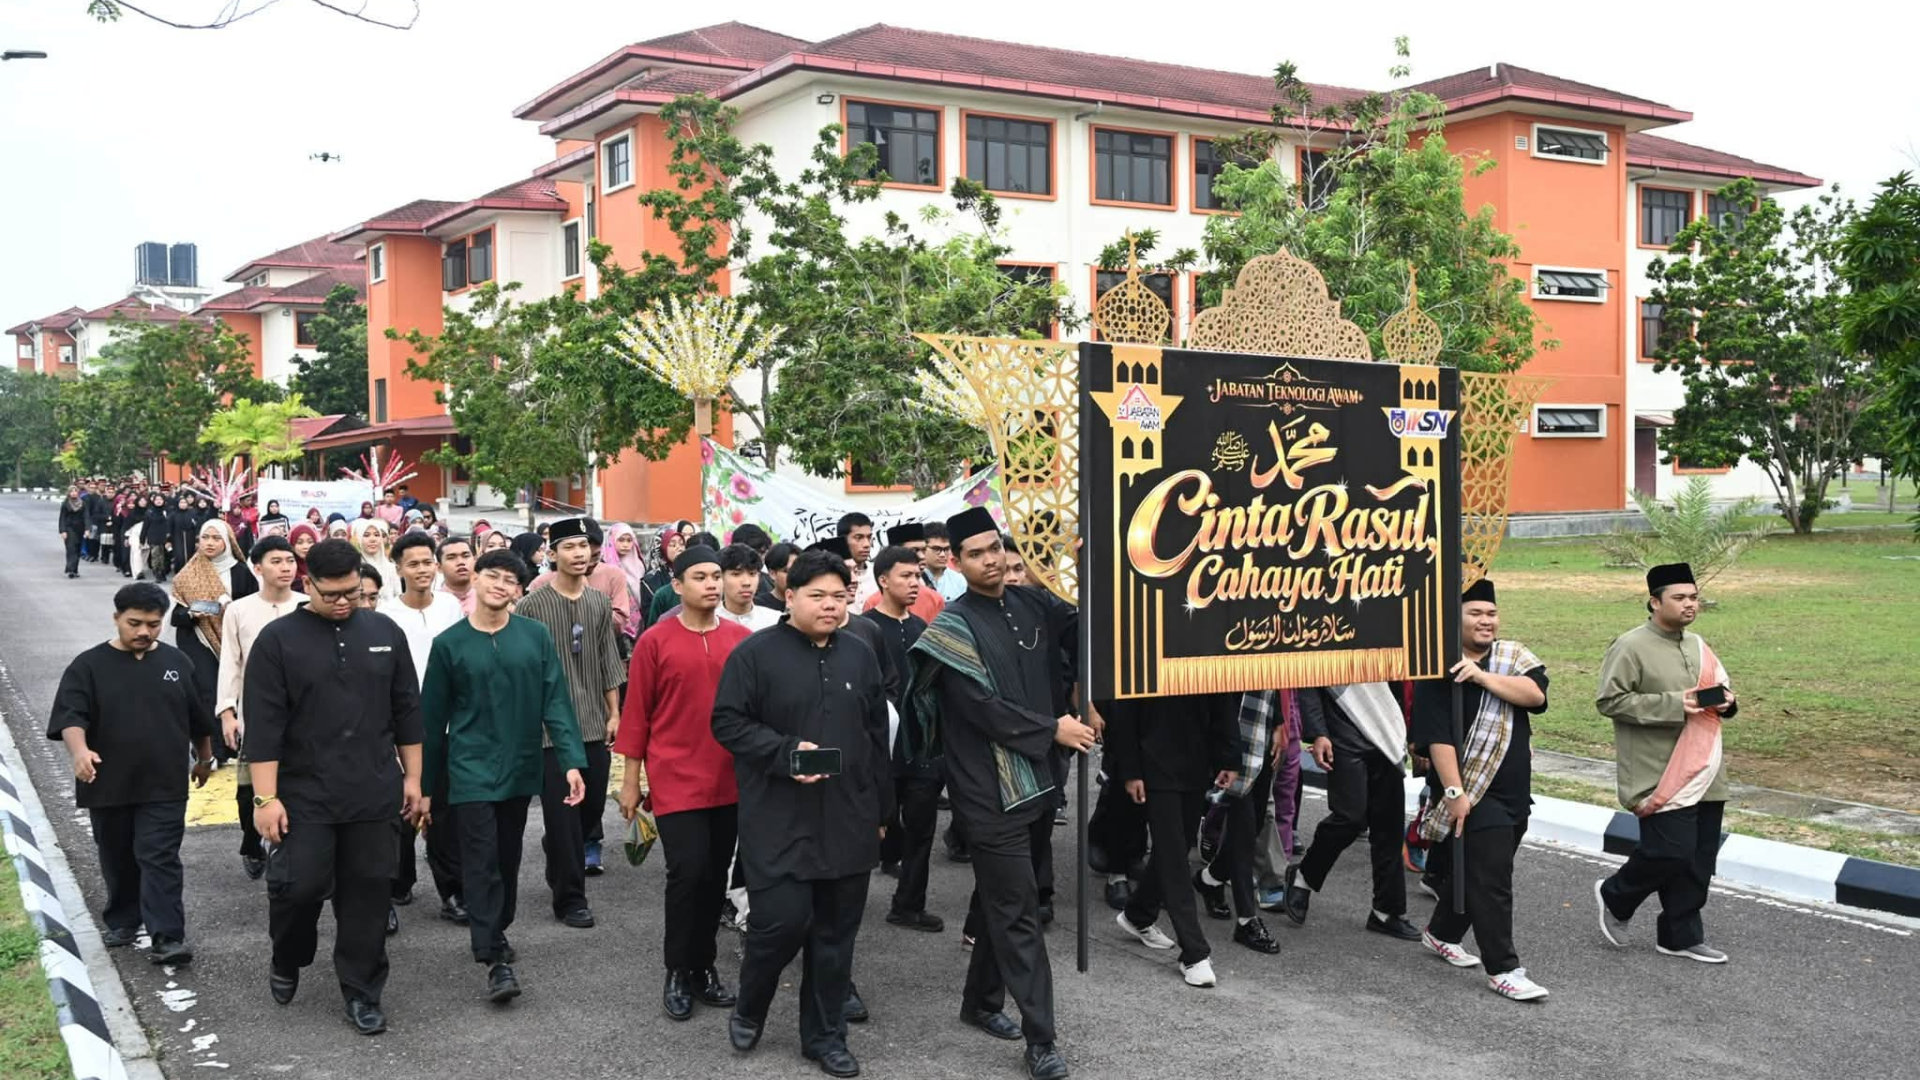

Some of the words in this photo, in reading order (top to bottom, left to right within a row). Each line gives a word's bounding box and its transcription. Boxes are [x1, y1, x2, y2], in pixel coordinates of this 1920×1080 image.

[1210, 378, 1264, 403] JABATAN
[1266, 382, 1326, 402] TEKNOLOGI
[1326, 386, 1359, 408] AWAM
[1406, 410, 1449, 432] IKSN
[1127, 469, 1294, 577] Cinta
[1287, 475, 1438, 564] Rasul,
[1186, 552, 1325, 612] Cahaya
[1324, 552, 1406, 604] Hati
